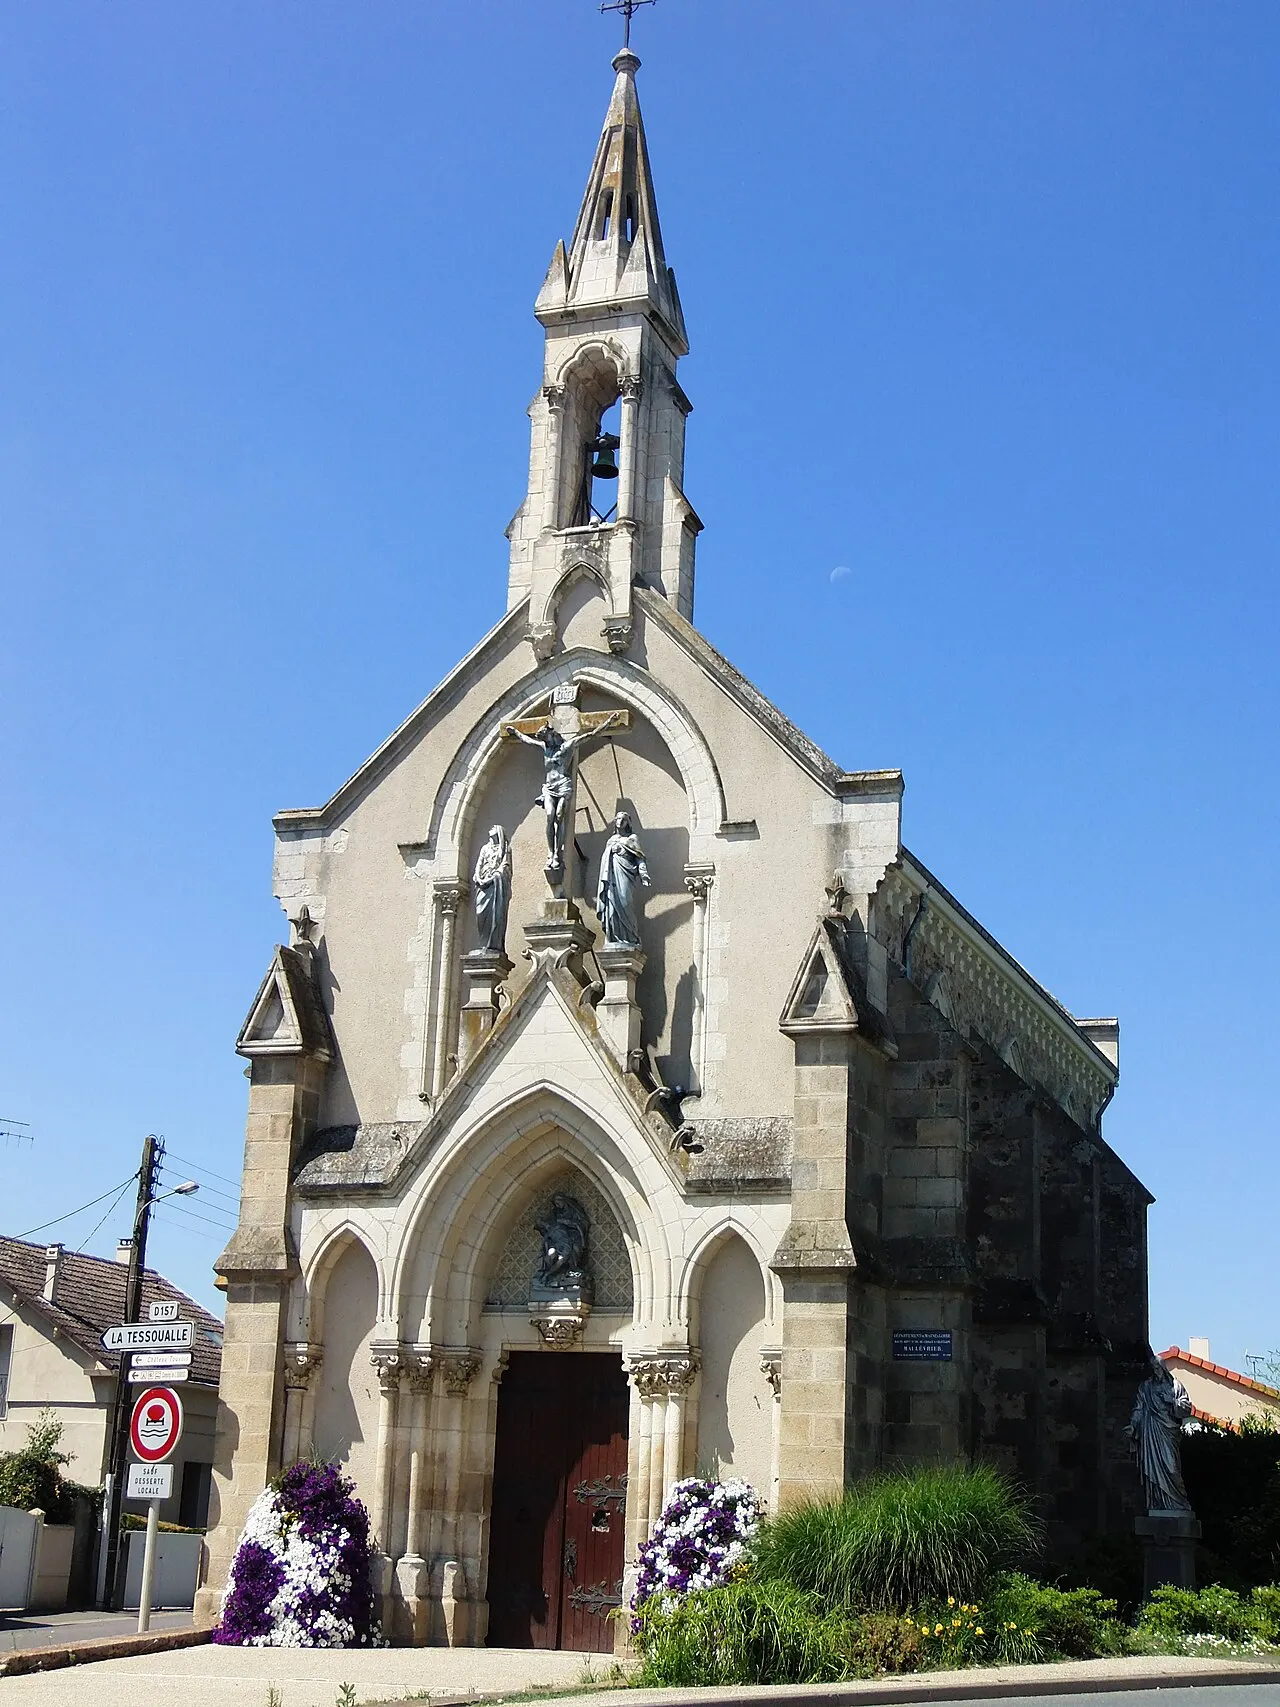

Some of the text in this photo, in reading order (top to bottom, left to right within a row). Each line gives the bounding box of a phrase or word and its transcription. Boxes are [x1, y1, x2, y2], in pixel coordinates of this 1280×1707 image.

[154, 1305, 175, 1317] D157
[111, 1328, 188, 1344] LA TESSOUALLE
[134, 1477, 164, 1485] DESSERTE
[137, 1487, 159, 1495] LOCALE
